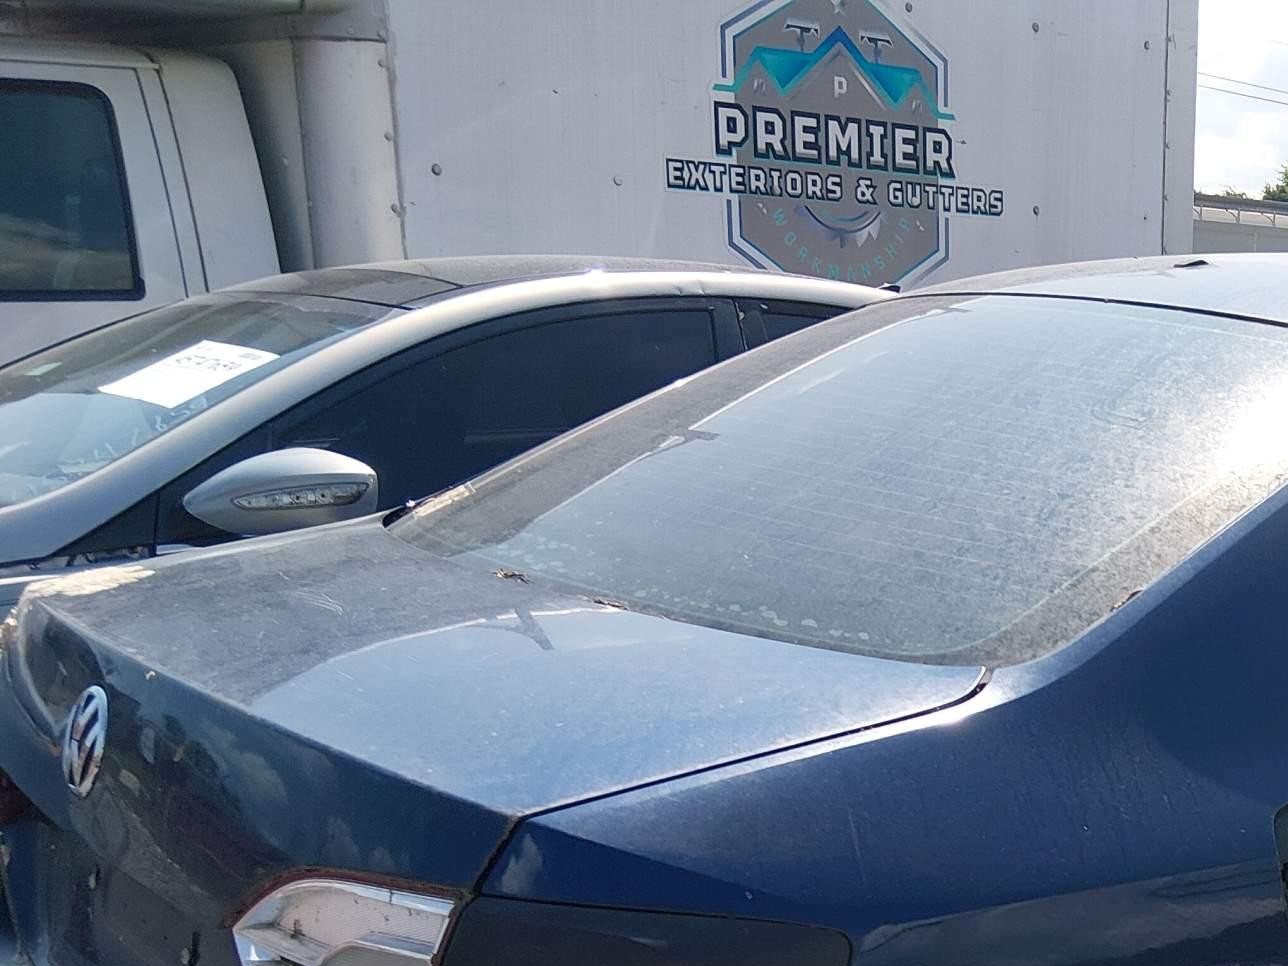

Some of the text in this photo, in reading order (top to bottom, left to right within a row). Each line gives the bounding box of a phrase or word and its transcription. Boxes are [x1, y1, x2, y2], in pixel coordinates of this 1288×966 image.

[714, 101, 956, 179] PREMIER
[666, 158, 1004, 217] EXTERIORS & GUTTERS
